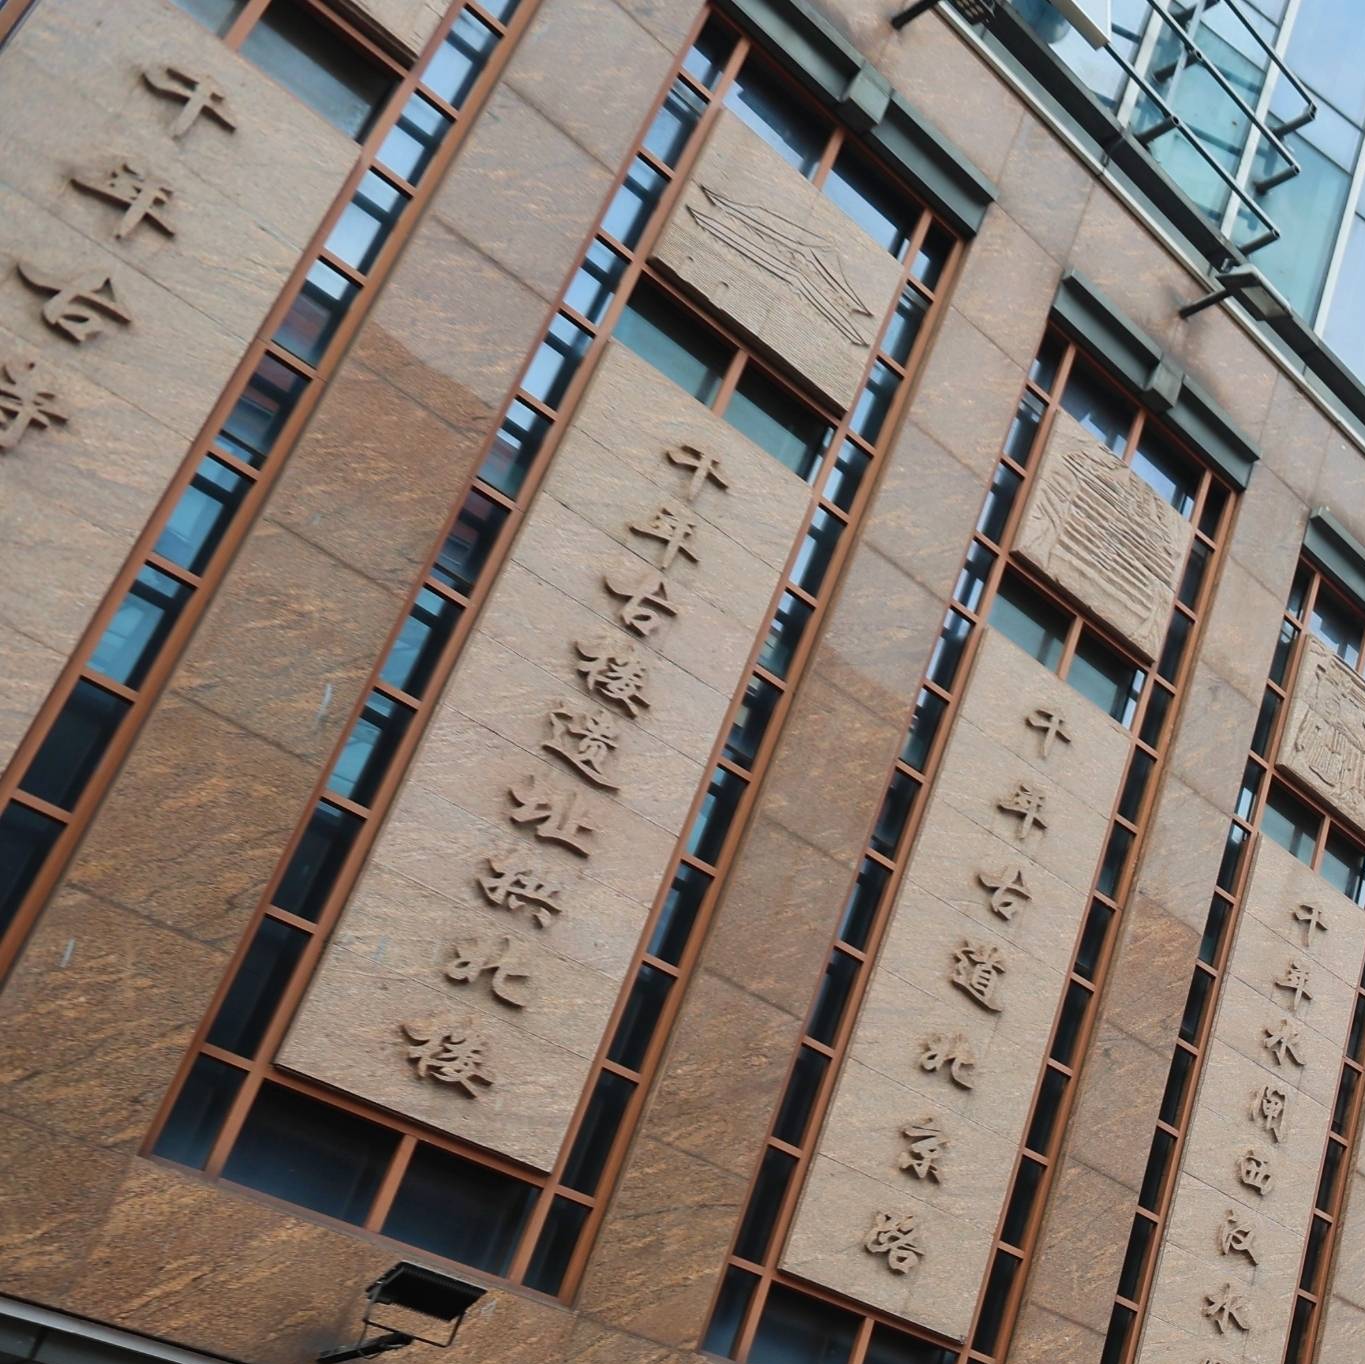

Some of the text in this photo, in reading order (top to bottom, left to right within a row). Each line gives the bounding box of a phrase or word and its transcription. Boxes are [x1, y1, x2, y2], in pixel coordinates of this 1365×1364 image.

[863, 706, 1072, 1276] 千年古道北京路
